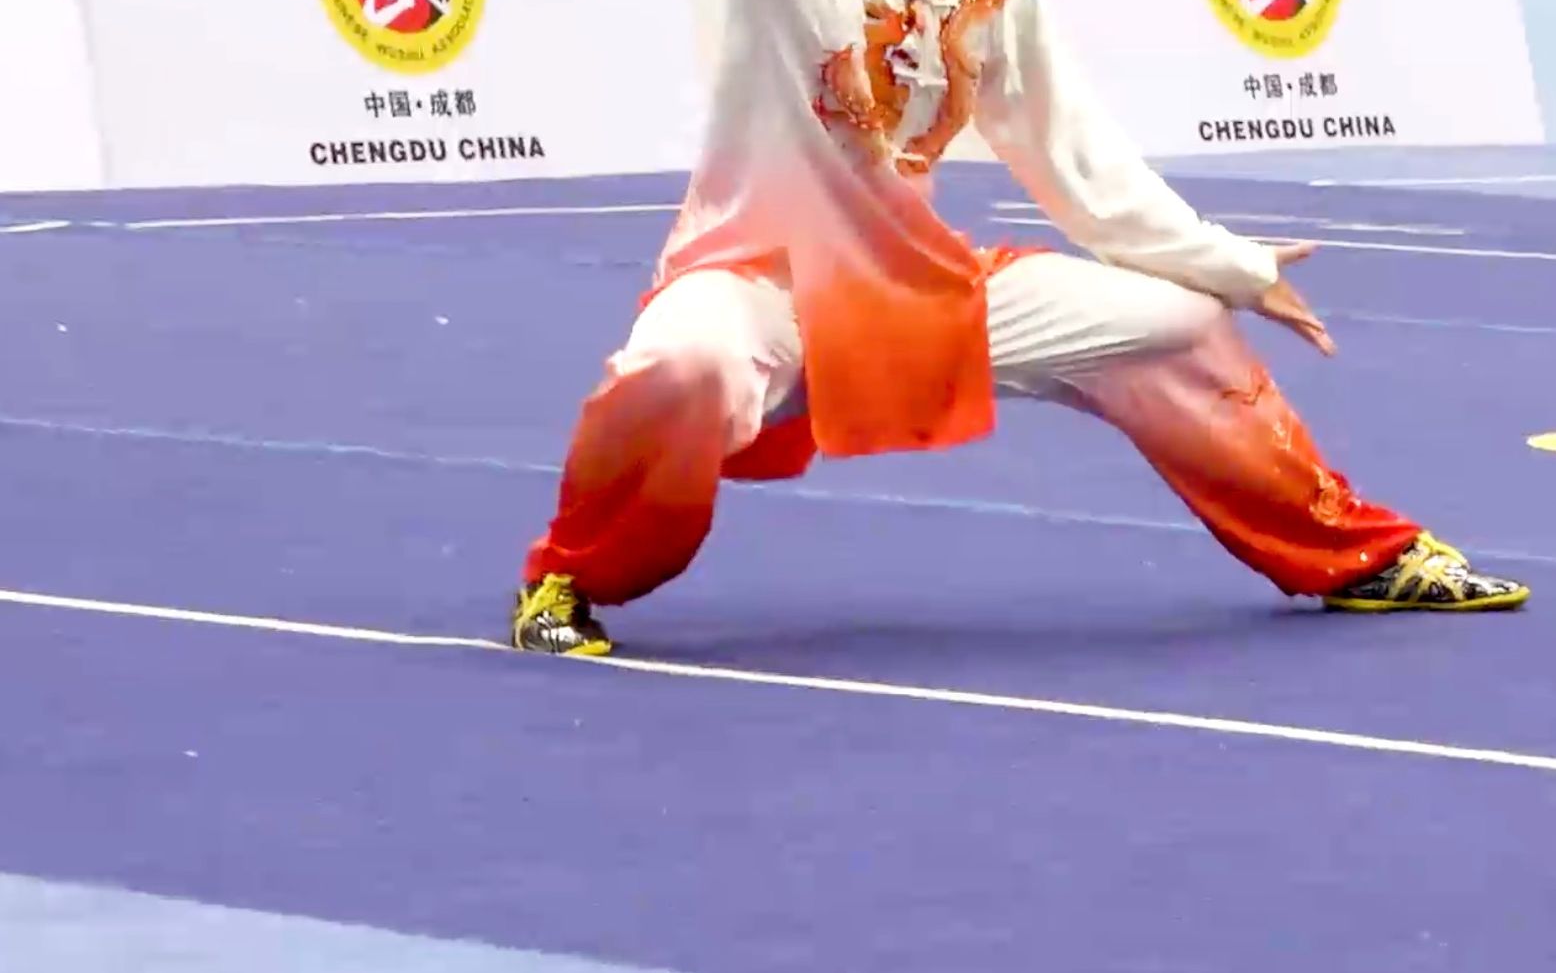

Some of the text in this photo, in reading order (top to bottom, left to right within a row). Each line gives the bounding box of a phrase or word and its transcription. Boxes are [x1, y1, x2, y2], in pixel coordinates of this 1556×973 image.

[1199, 114, 1397, 141] CHENGDU CHINA
[309, 134, 547, 165] CHENGDU CHINA
